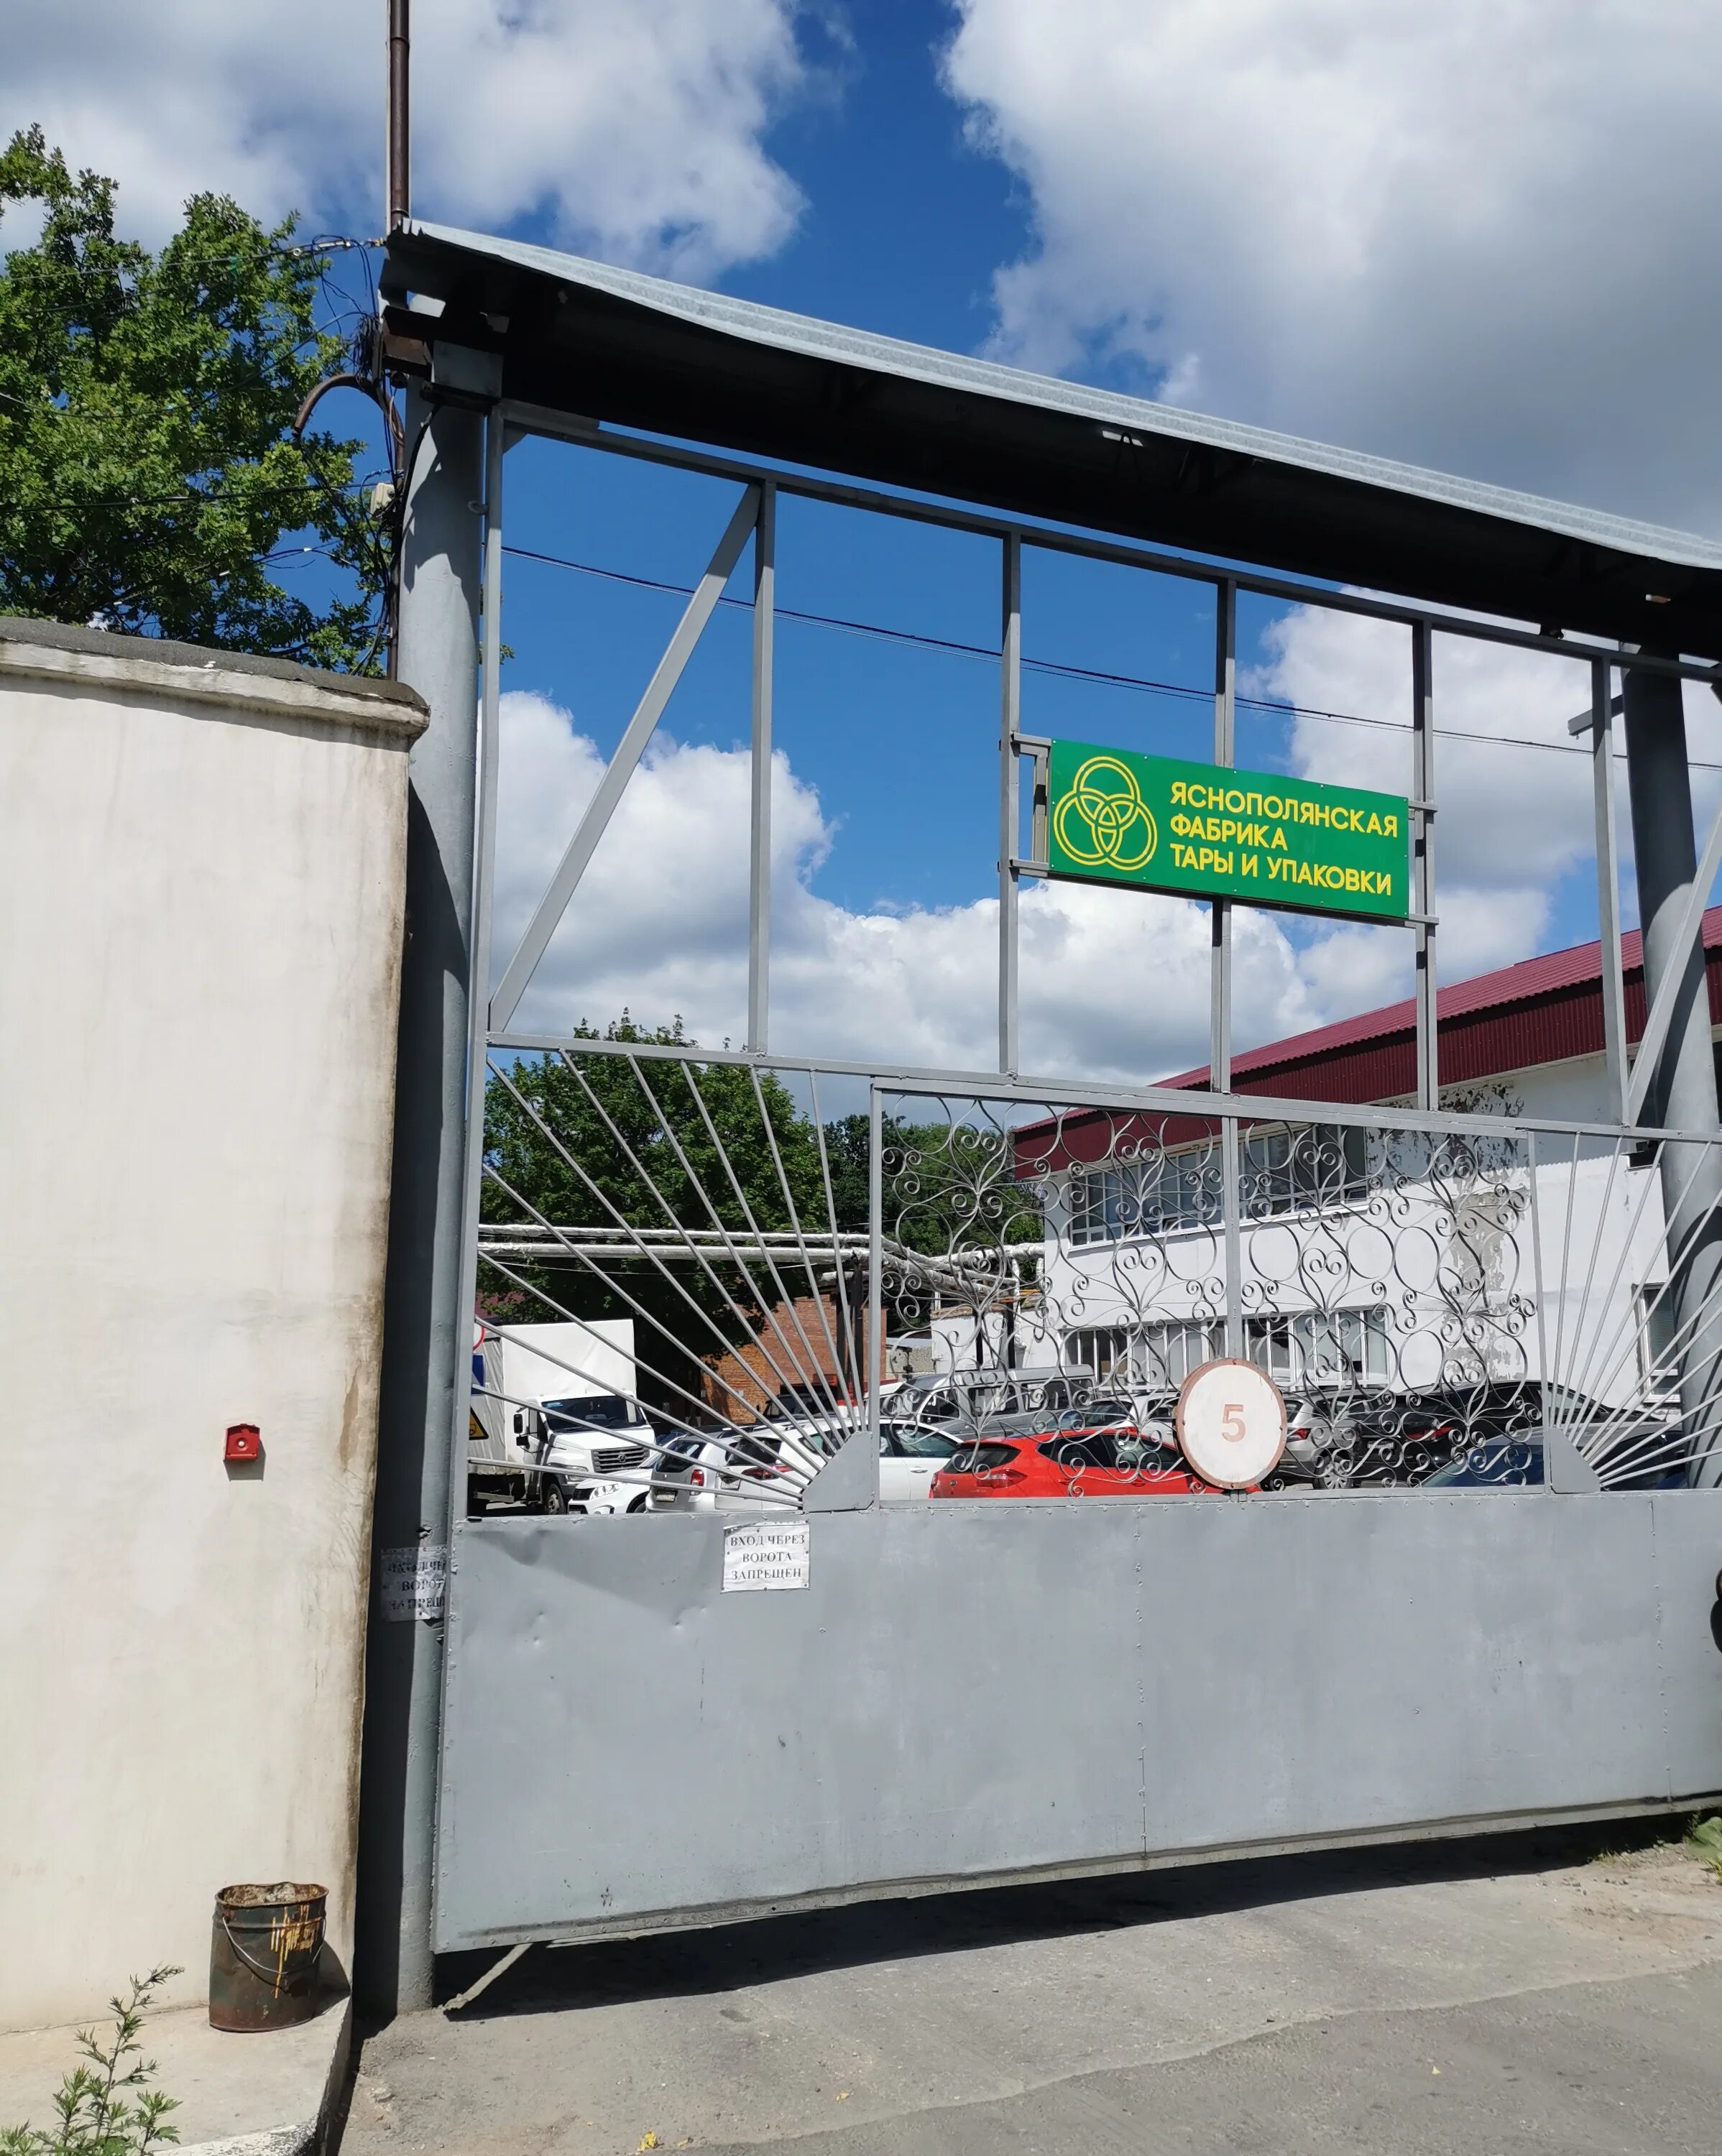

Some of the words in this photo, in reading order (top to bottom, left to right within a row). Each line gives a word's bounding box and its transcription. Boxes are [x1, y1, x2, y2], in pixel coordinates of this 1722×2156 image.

[1170, 781, 1397, 838] ЯСНОПОЛЯНСКАЯ
[1170, 813, 1288, 851] ФАБРИКА
[1170, 843, 1233, 875] ТАРЫ
[1241, 853, 1258, 877] И
[1266, 856, 1391, 895] УПАКОВКИ
[1222, 1404, 1246, 1442] 5
[730, 1535, 764, 1547] ВХОД
[767, 1534, 805, 1545] ЧЕРЕЗ
[742, 1552, 793, 1563] ВОРОТА
[402, 1579, 444, 1591] ВОРОТ
[732, 1568, 801, 1580] ЗАПРЕЩЕН
